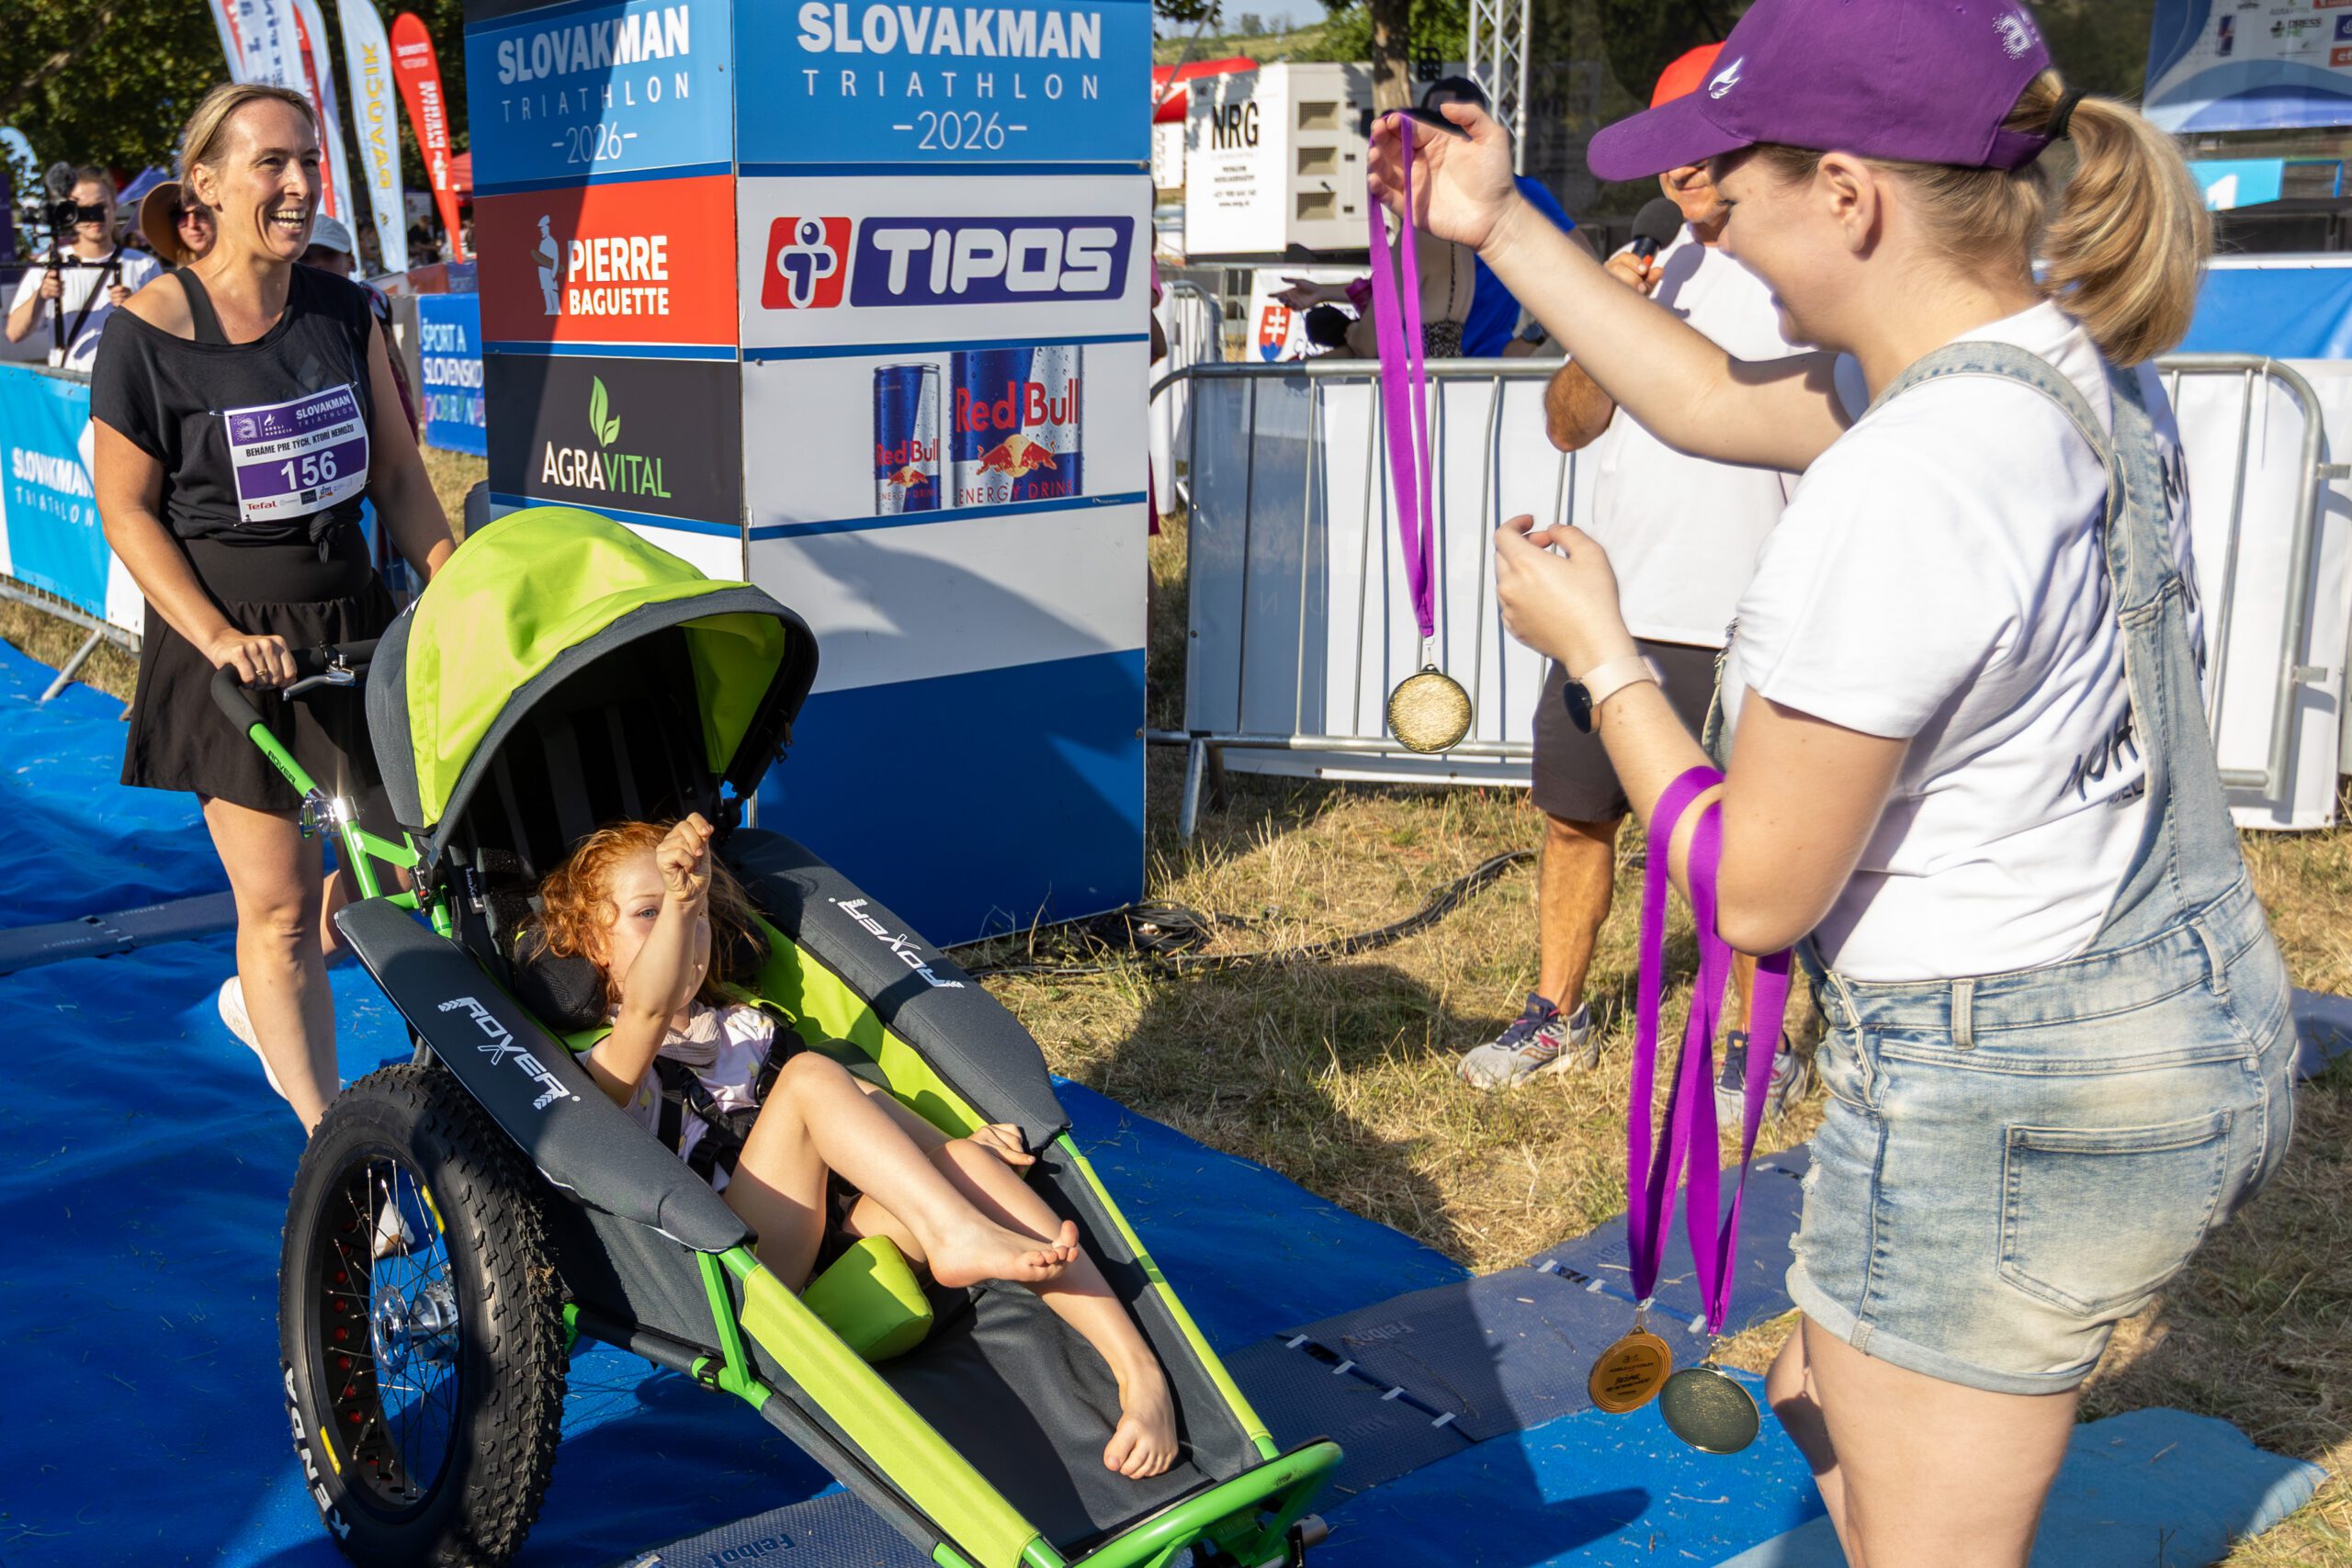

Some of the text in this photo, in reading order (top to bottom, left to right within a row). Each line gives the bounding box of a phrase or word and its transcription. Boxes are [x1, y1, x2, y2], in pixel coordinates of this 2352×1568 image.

[497, 5, 689, 85] SLOVAKMAN
[797, 2, 1101, 59] SLOVAKMAN
[502, 72, 689, 123] TRIATHLON
[802, 69, 1098, 100] TRIATHLON
[1212, 101, 1259, 150] NRG
[568, 235, 668, 283] PIERRE
[872, 227, 1117, 296] TIPOS
[569, 288, 670, 315] BAGUETTE
[457, 324, 467, 352] A
[296, 394, 351, 420] SLOVAKMAN
[955, 378, 1080, 434] Red Bull
[245, 444, 276, 457] BEHÁME
[277, 441, 291, 453] PRE
[280, 450, 337, 491] 156
[541, 441, 672, 499] AGRAVITAL
[876, 438, 939, 467] Red Bull
[958, 479, 1073, 505] ENERGY DRINK
[285, 1367, 351, 1540] KENDA
